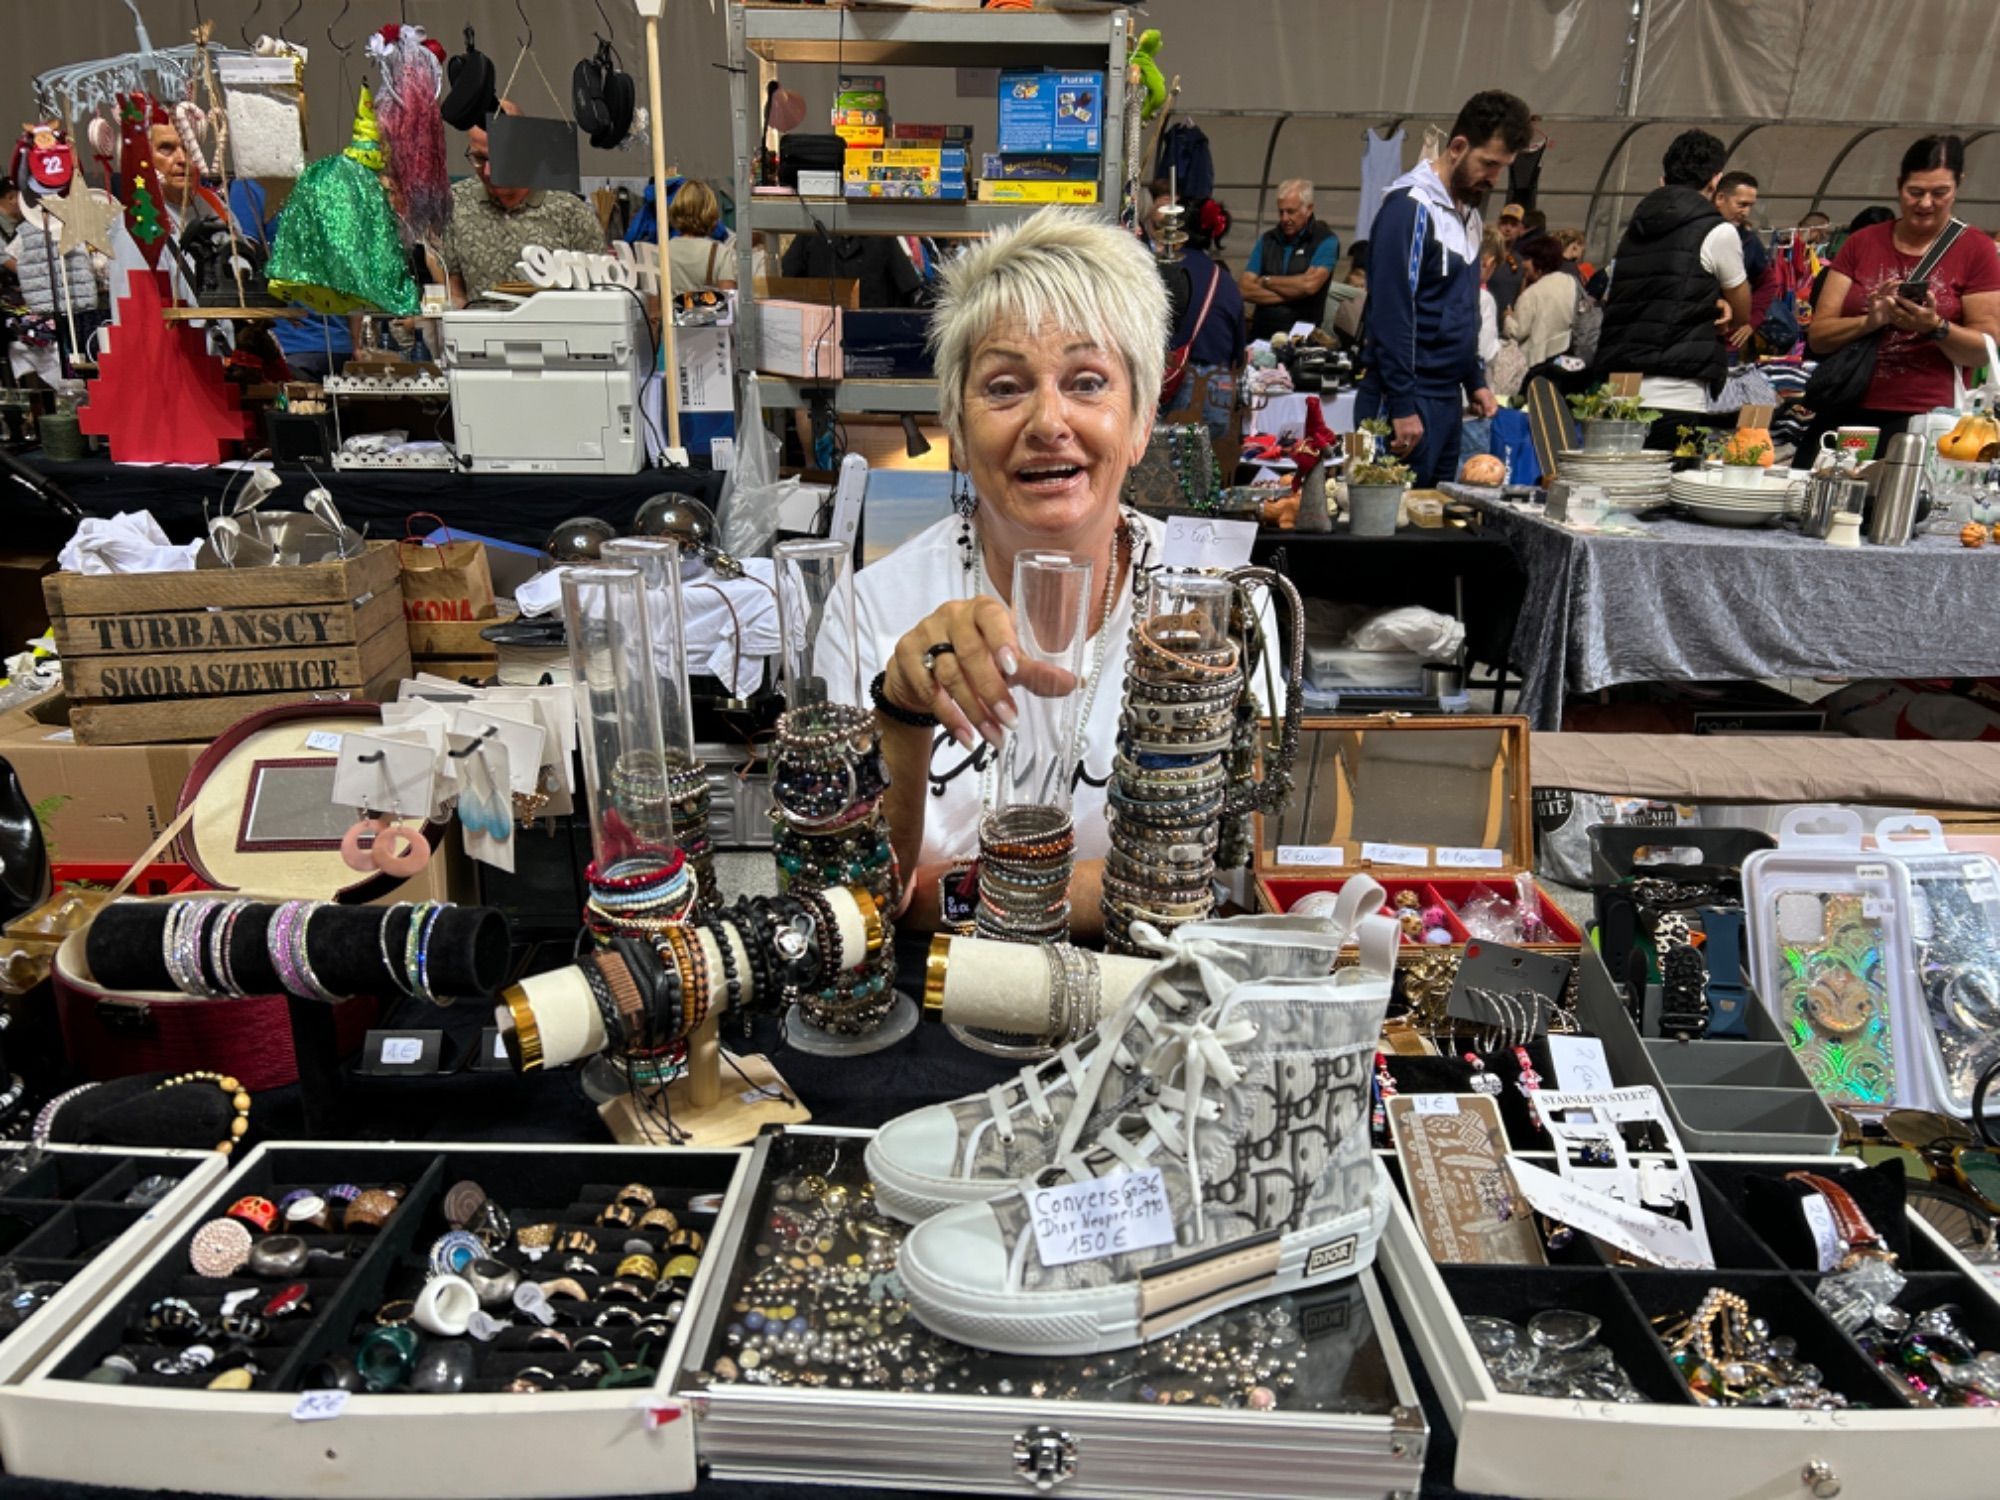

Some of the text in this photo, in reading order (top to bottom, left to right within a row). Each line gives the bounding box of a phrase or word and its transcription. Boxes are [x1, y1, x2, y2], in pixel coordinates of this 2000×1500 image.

[42, 155, 65, 175] 22
[1171, 522, 1184, 541] 3
[91, 611, 332, 650] TURBANSCY
[100, 659, 340, 698] SKORASZEWICE
[1540, 1094, 1608, 1105] STAINLESS
[1067, 1233, 1107, 1255] 150
[1313, 1245, 1349, 1267] DIOR
